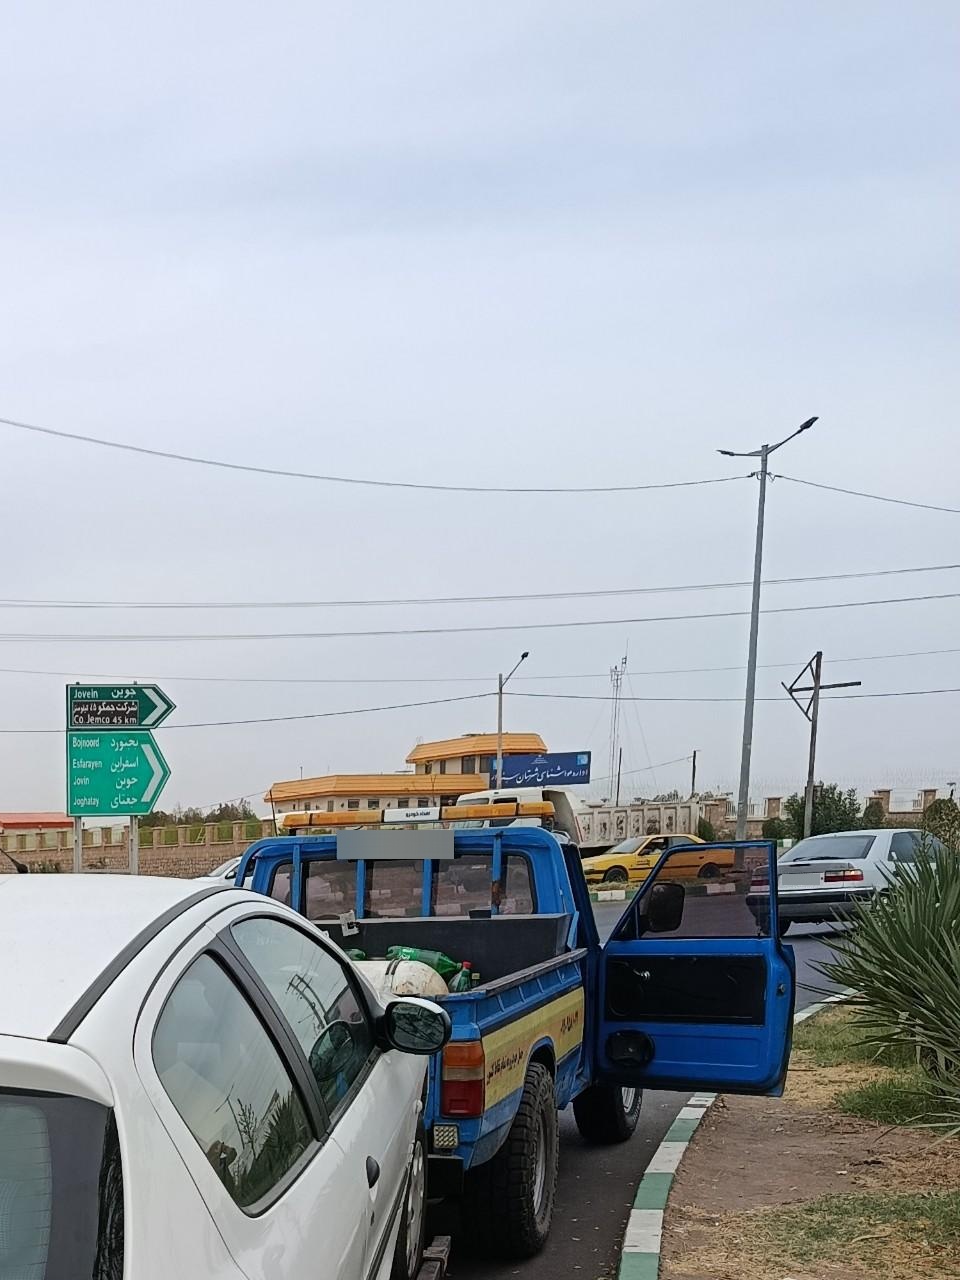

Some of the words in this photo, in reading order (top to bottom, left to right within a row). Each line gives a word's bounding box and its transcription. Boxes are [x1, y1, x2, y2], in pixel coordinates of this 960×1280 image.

[74, 689, 99, 698] Jovein
[111, 688, 136, 699] جوین
[116, 702, 138, 714] شرکت
[86, 714, 110, 724] Jemco
[113, 716, 123, 724] 45
[125, 716, 137, 724] km
[72, 737, 100, 749] Bojnoord
[110, 738, 138, 751] بجنورد
[72, 758, 103, 771] Esfarayen
[110, 756, 138, 772] اسفراین
[73, 776, 90, 785] Jovin
[115, 777, 138, 790] جوین
[110, 793, 138, 809] جغتای
